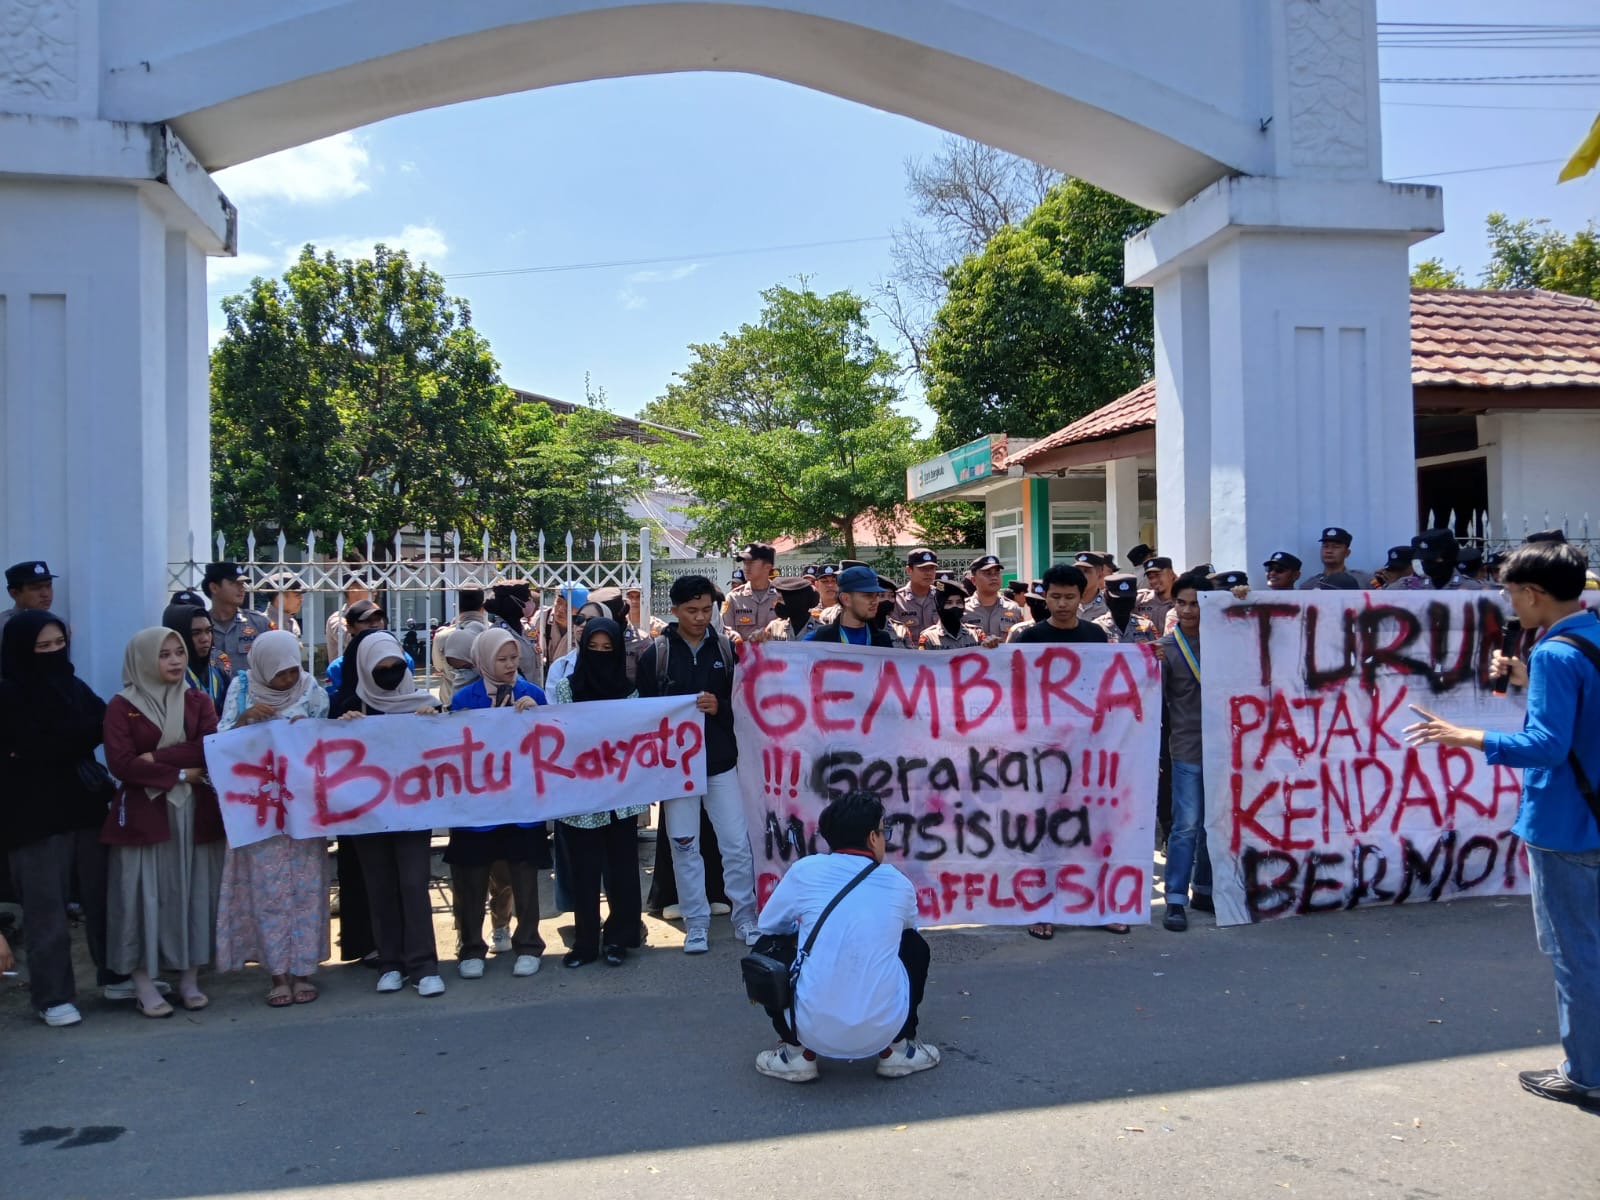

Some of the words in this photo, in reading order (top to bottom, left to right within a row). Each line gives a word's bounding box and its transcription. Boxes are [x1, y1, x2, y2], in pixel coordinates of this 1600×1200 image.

[742, 646, 1143, 738] GEMBIRA
[1229, 684, 1408, 770] PAJAK
[520, 716, 703, 796] Rakyat?
[811, 746, 1072, 802] Gerakan
[765, 801, 1091, 862] Masiswa
